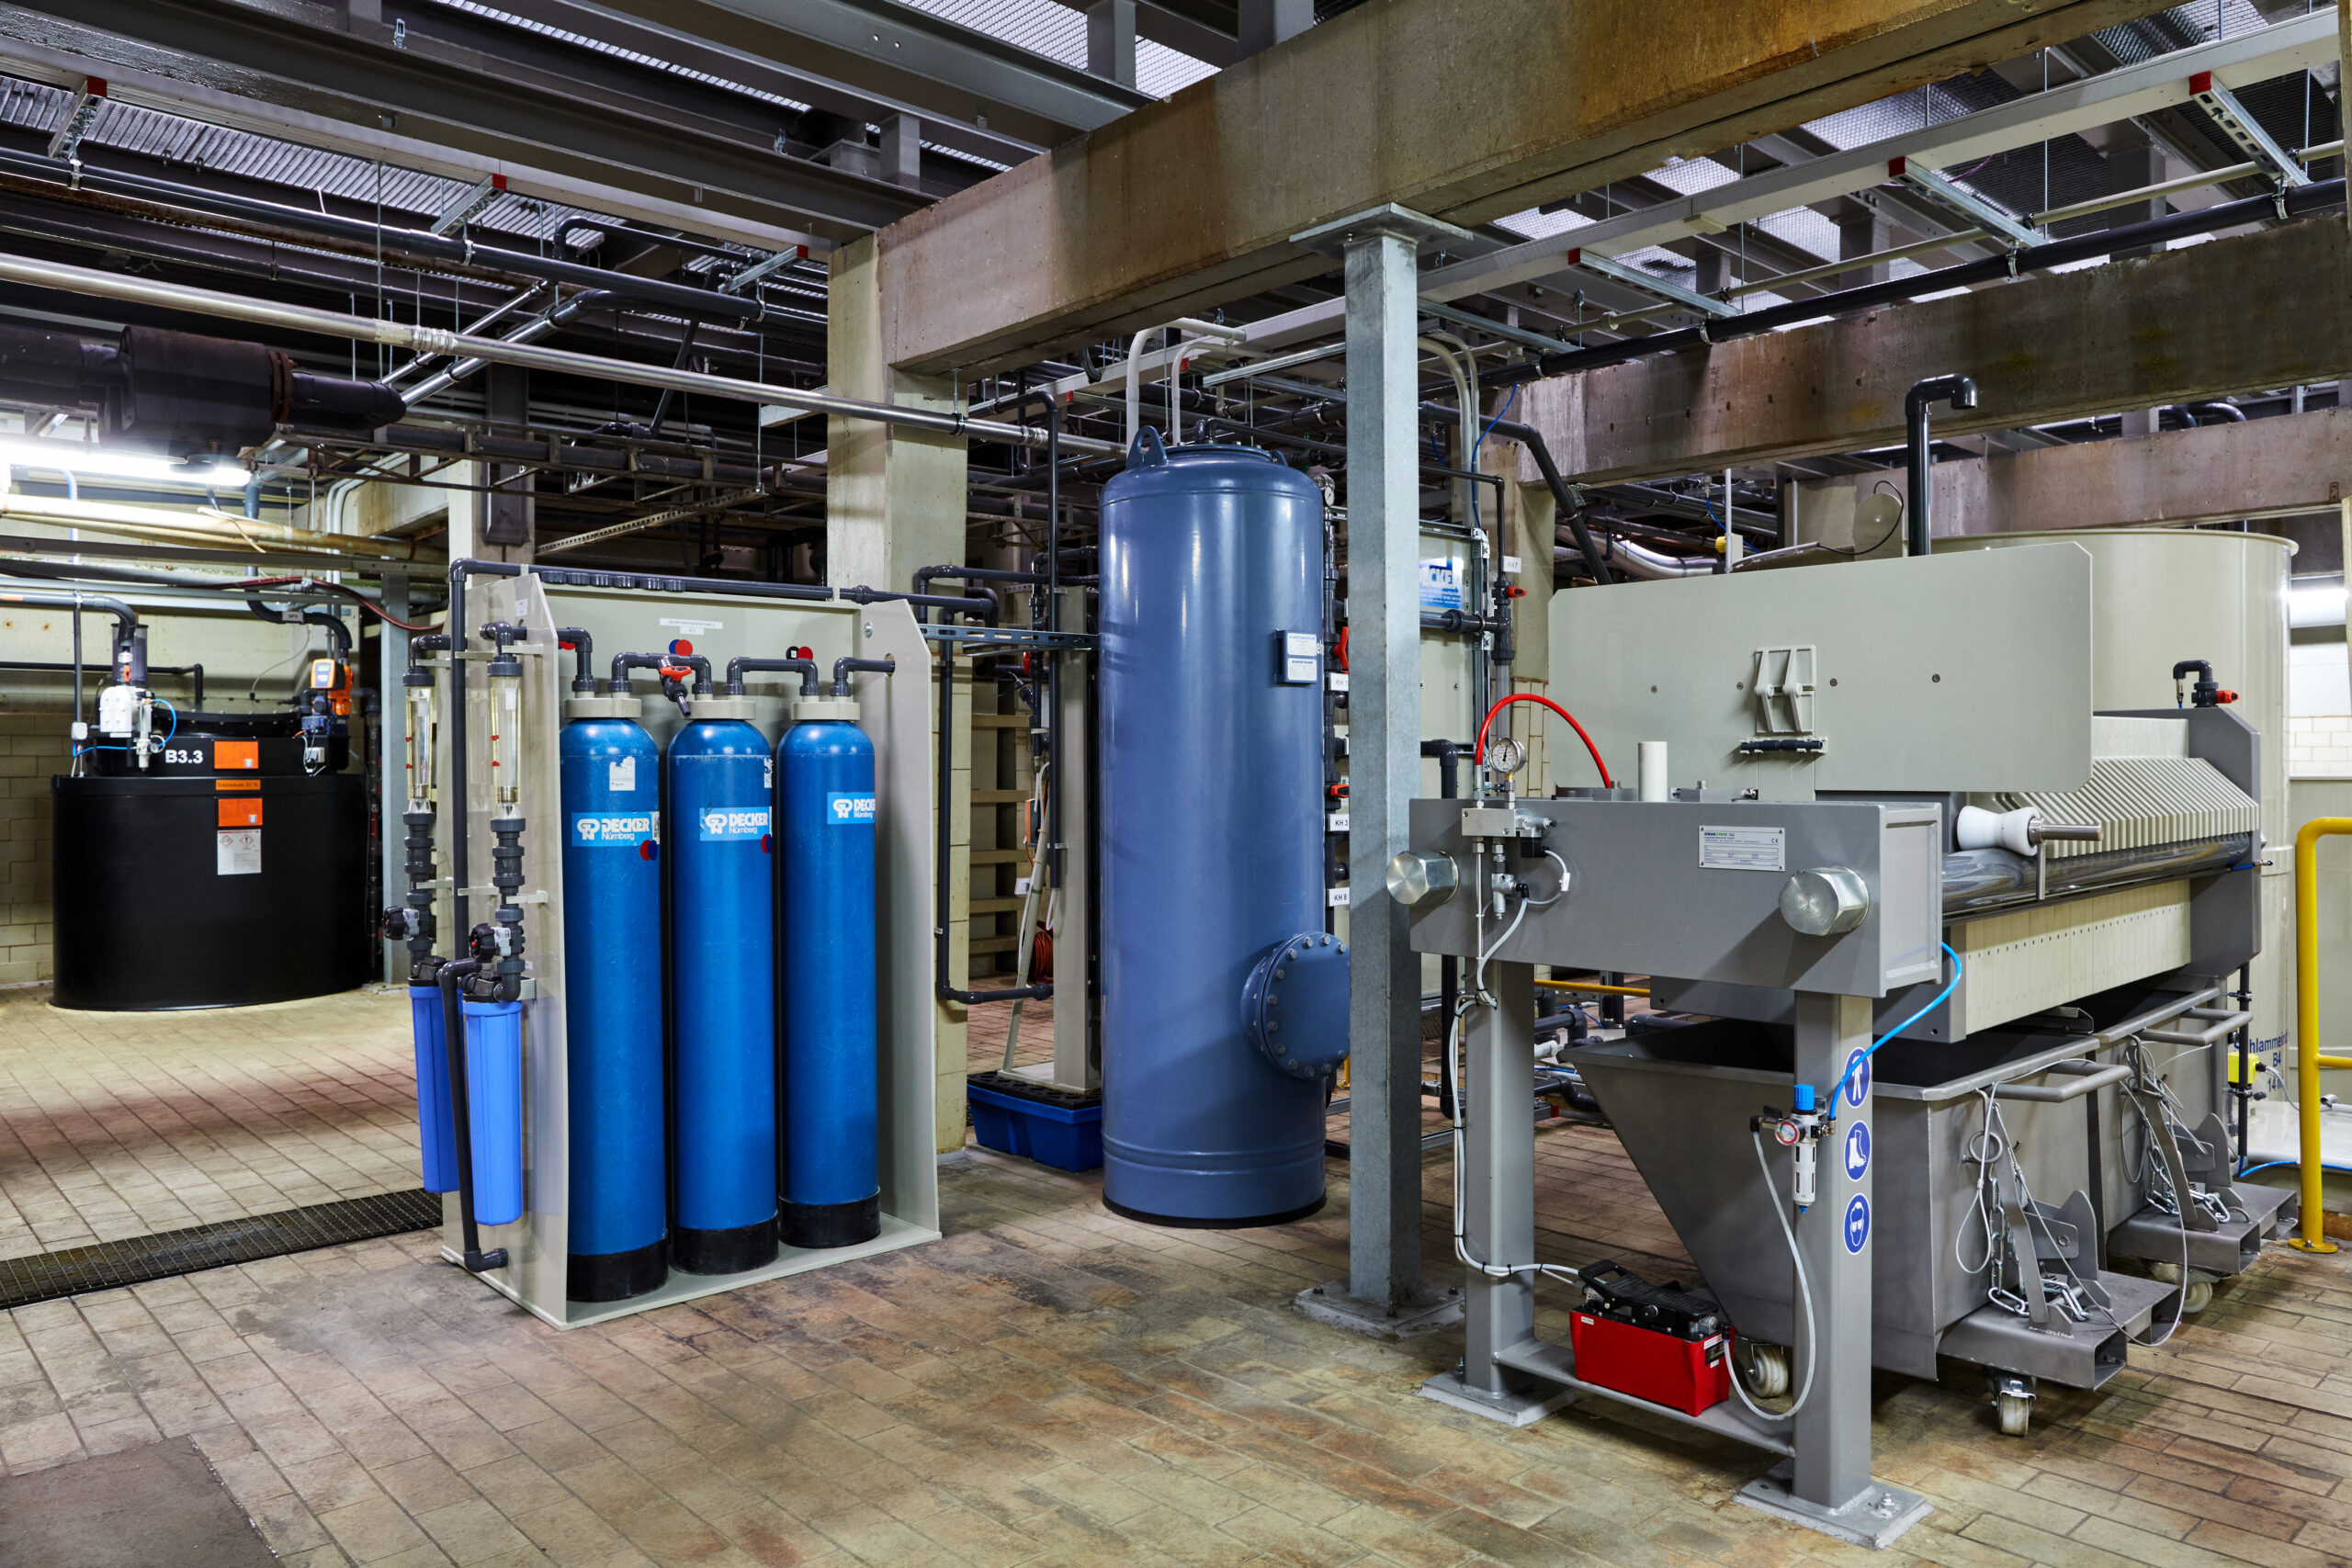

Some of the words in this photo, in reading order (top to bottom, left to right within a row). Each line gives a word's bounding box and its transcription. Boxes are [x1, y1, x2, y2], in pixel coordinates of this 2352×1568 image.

[164, 750, 204, 764] B3.3
[601, 818, 650, 833] DECKER
[729, 812, 768, 827] DECKER
